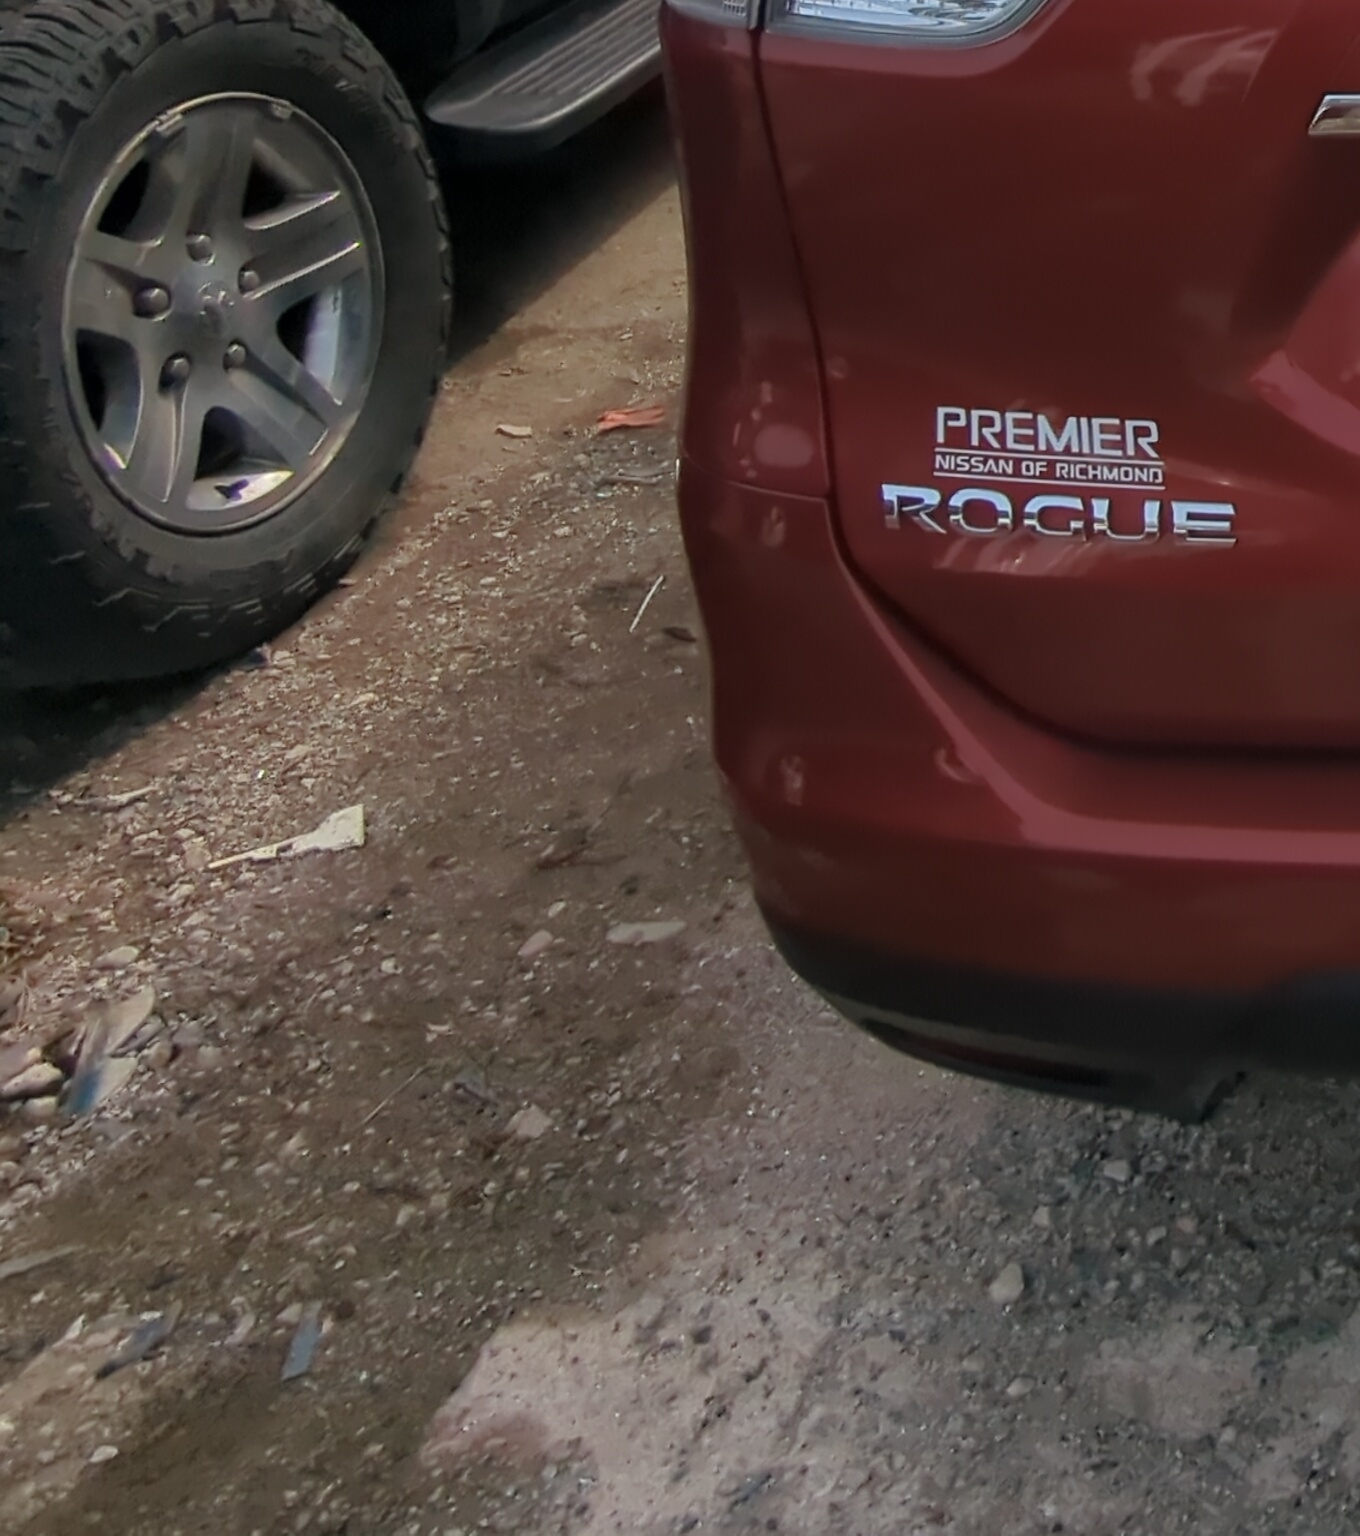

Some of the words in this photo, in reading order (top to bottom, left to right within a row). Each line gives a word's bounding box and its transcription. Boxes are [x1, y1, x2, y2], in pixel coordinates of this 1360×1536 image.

[936, 406, 1160, 458] PREMIER
[934, 454, 1014, 476] NISSAN
[1021, 459, 1049, 478] OF
[1055, 462, 1164, 484] RICHMOND
[881, 483, 1238, 547] ROGUE
